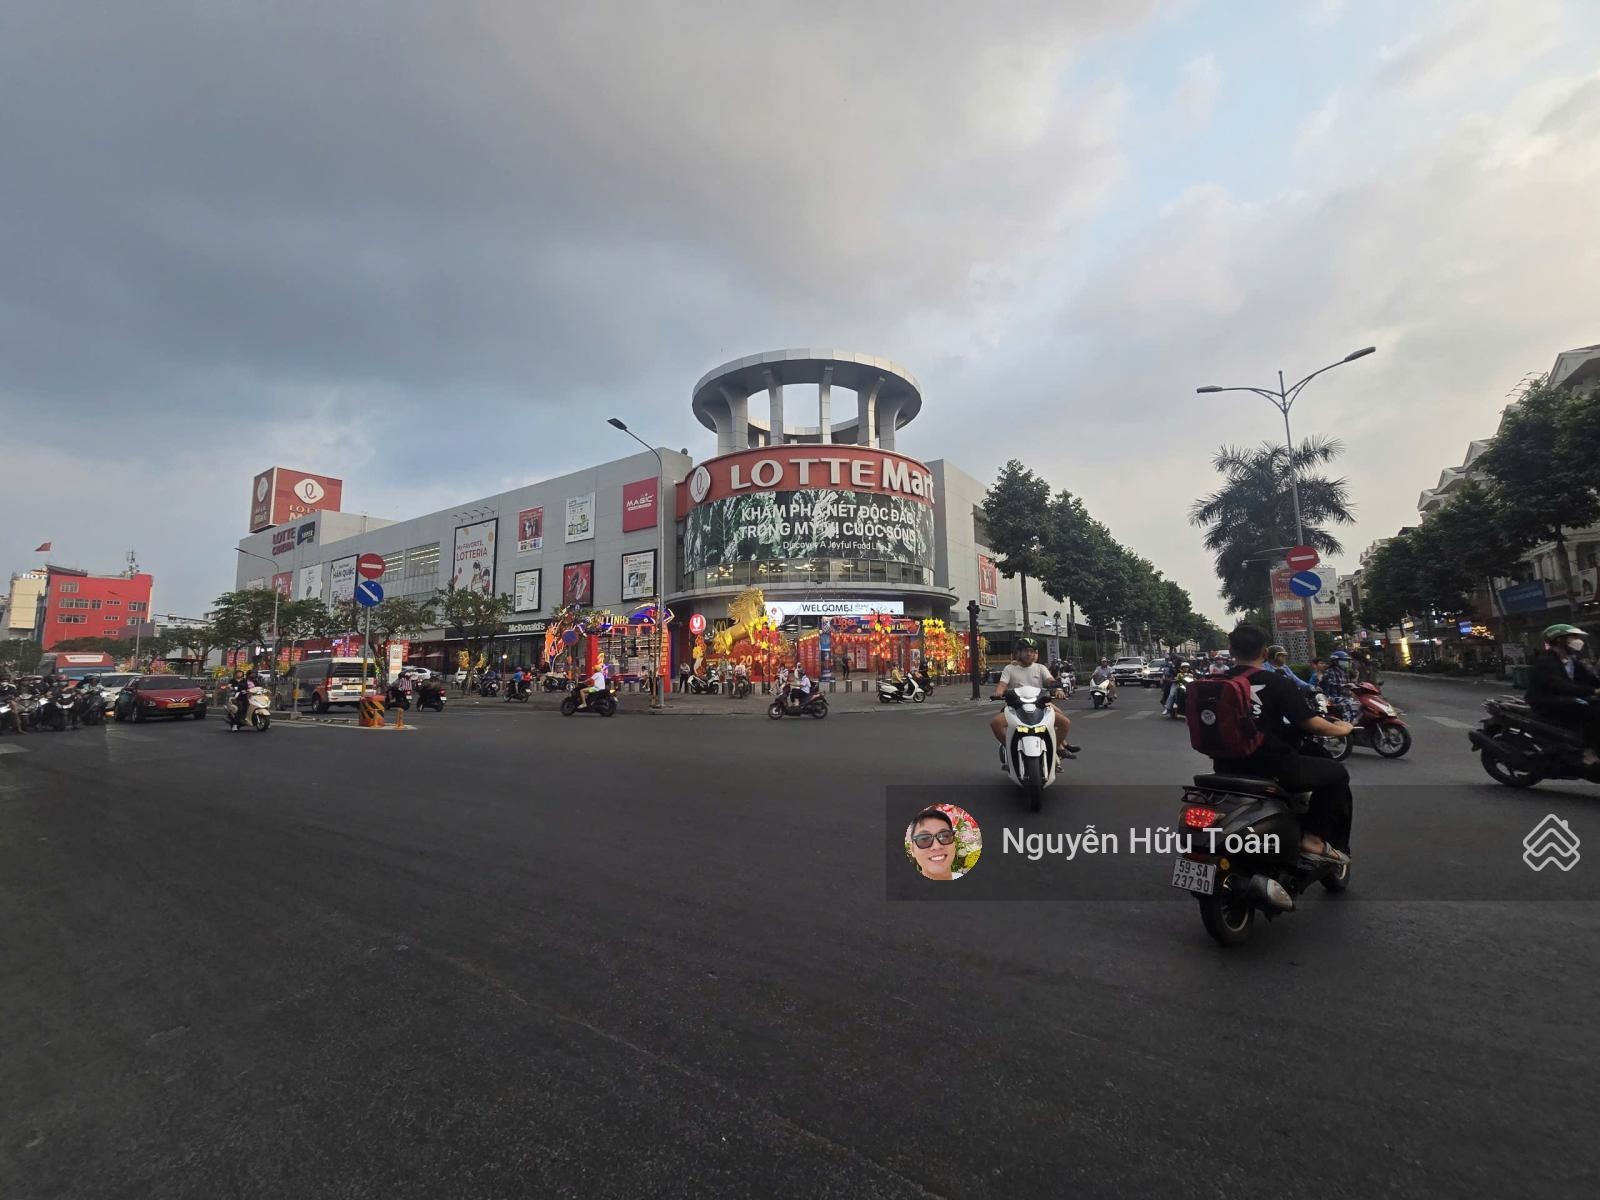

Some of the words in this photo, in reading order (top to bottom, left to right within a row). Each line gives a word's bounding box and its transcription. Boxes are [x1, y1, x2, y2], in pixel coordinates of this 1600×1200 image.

[731, 456, 876, 490] LOTTE
[456, 547, 488, 562] LOTTERIA
[508, 622, 546, 633] McDonald's
